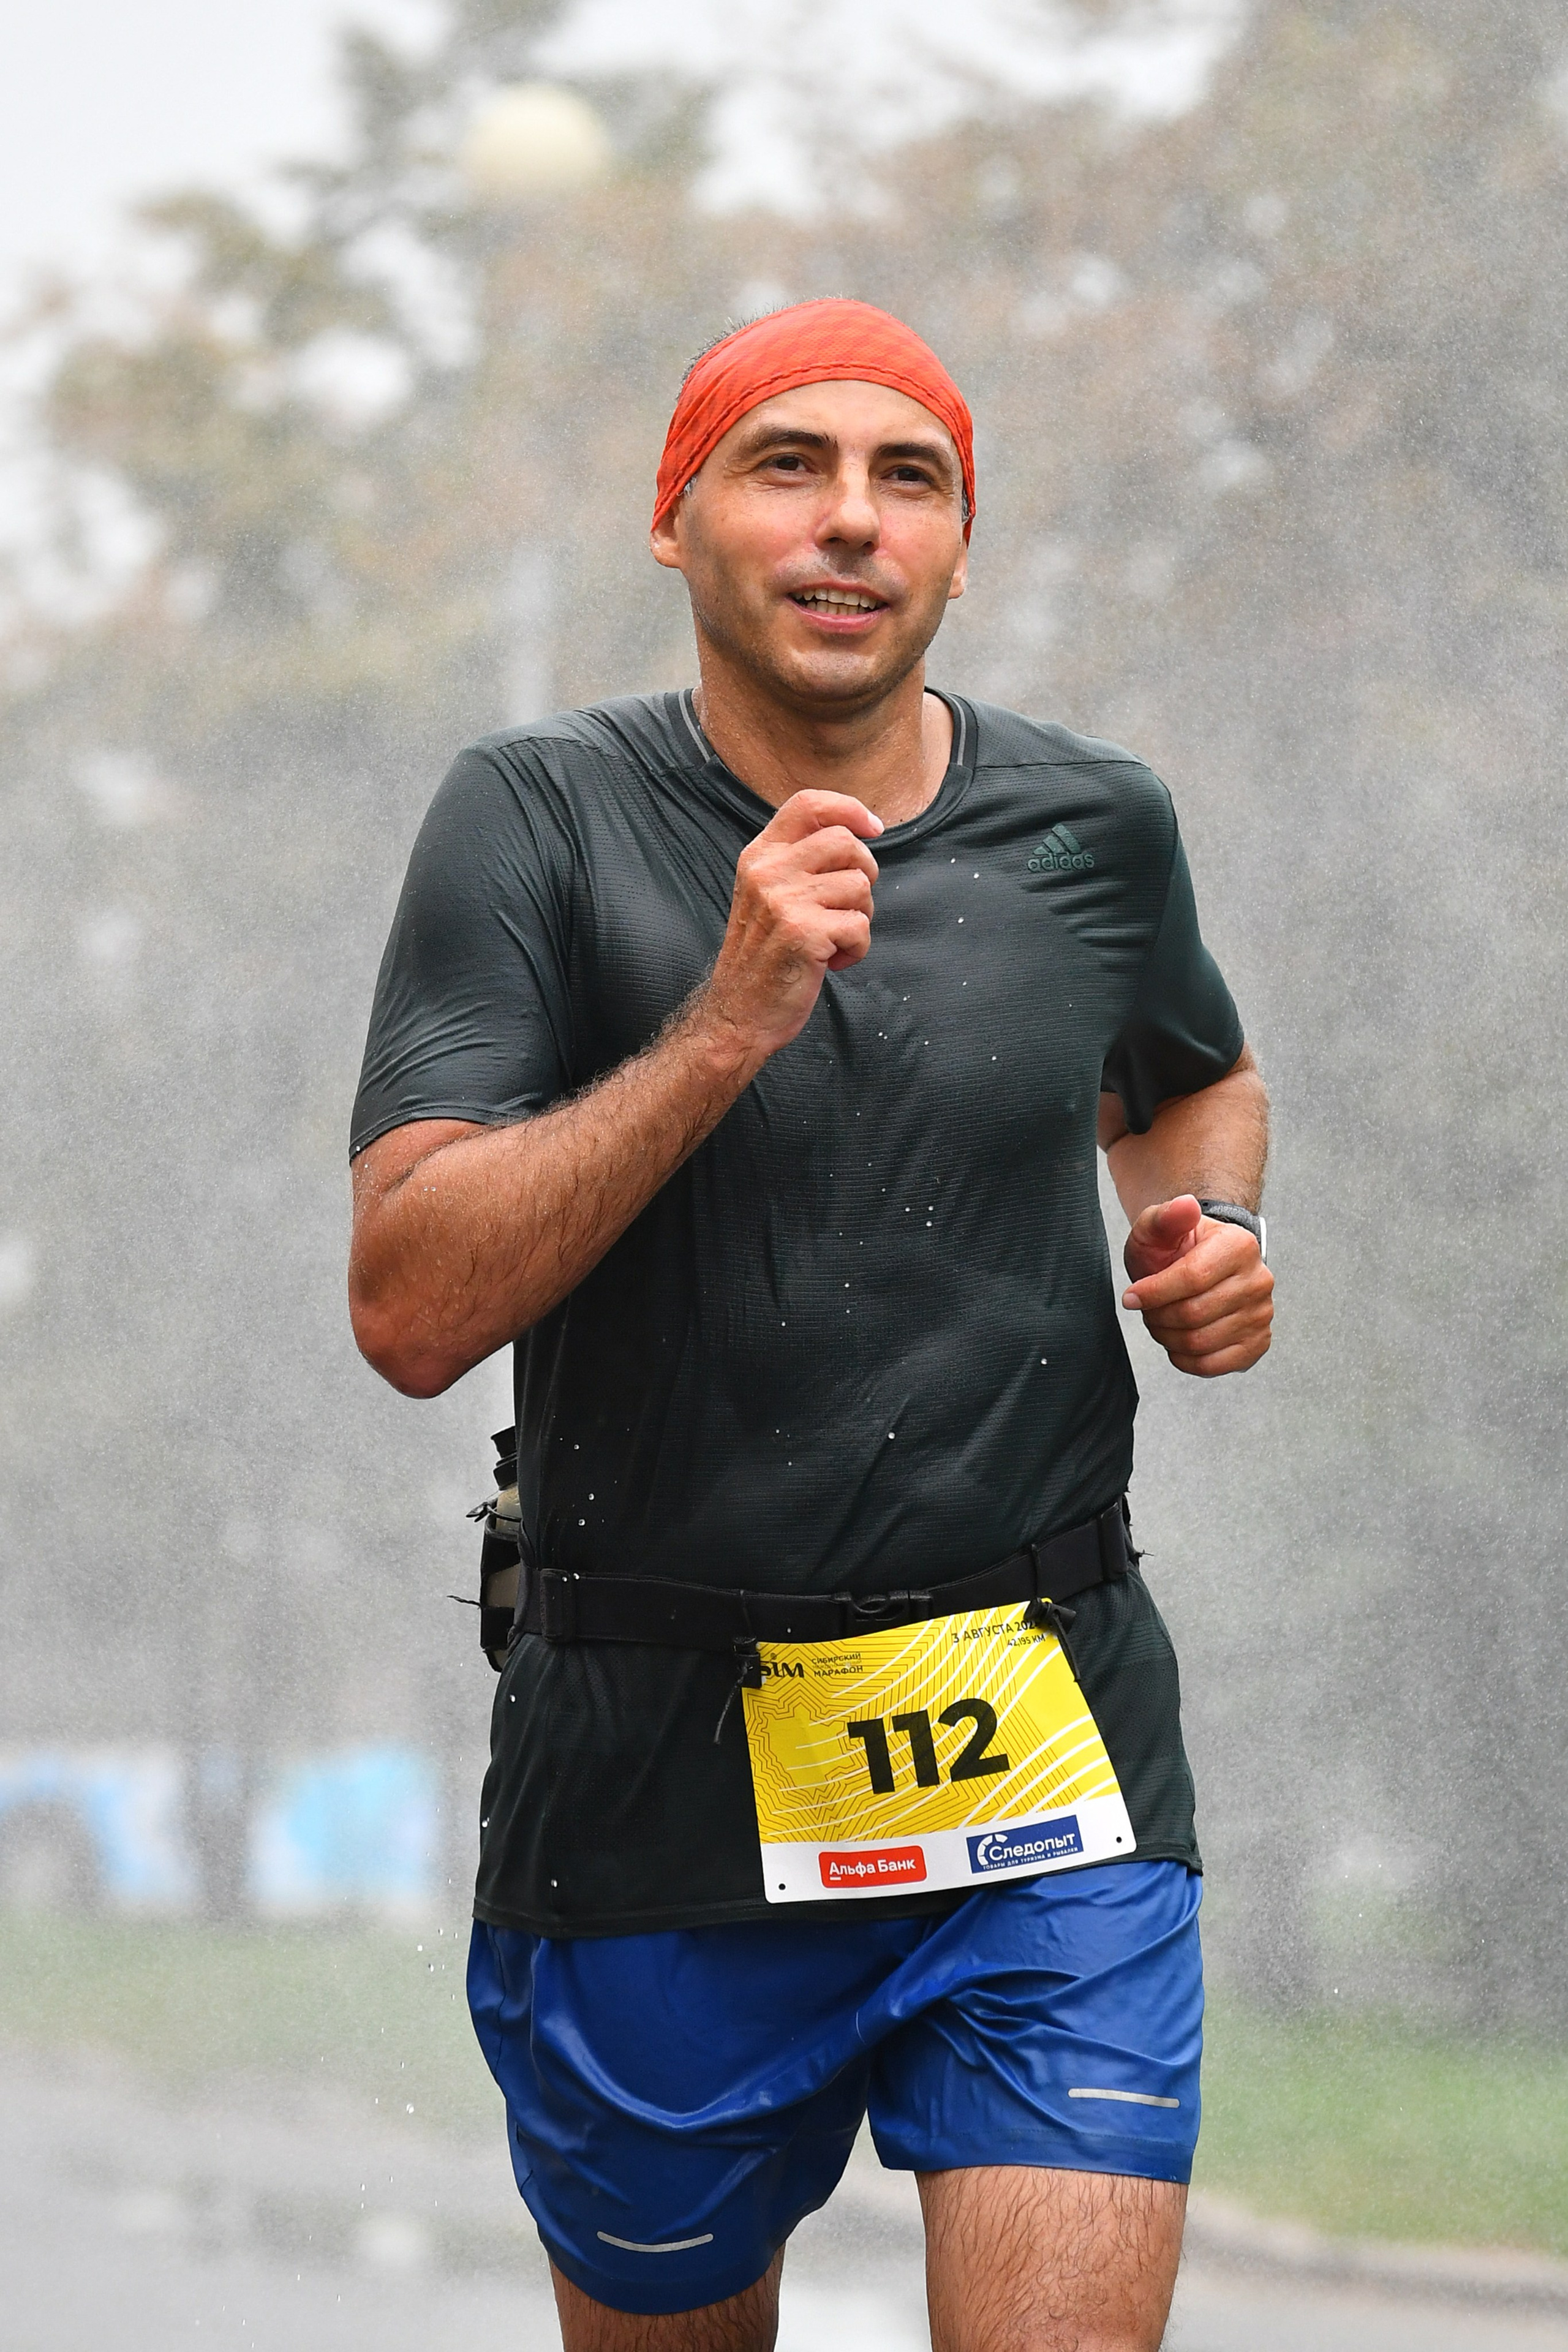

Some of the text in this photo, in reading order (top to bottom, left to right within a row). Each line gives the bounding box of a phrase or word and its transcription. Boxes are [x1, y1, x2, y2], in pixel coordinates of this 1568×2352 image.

[1027, 854, 1095, 872] adidas
[951, 1620, 1040, 1643] 3 АВГУСТА 202
[1008, 1637, 1031, 1646] 42,195
[811, 1653, 861, 1664] СИБИРСКИЙ
[813, 1665, 863, 1677] МАРАФОН
[847, 1698, 1010, 1794] 112
[989, 1833, 1075, 1861] Следопыт
[829, 1859, 916, 1880] Альфа Банк
